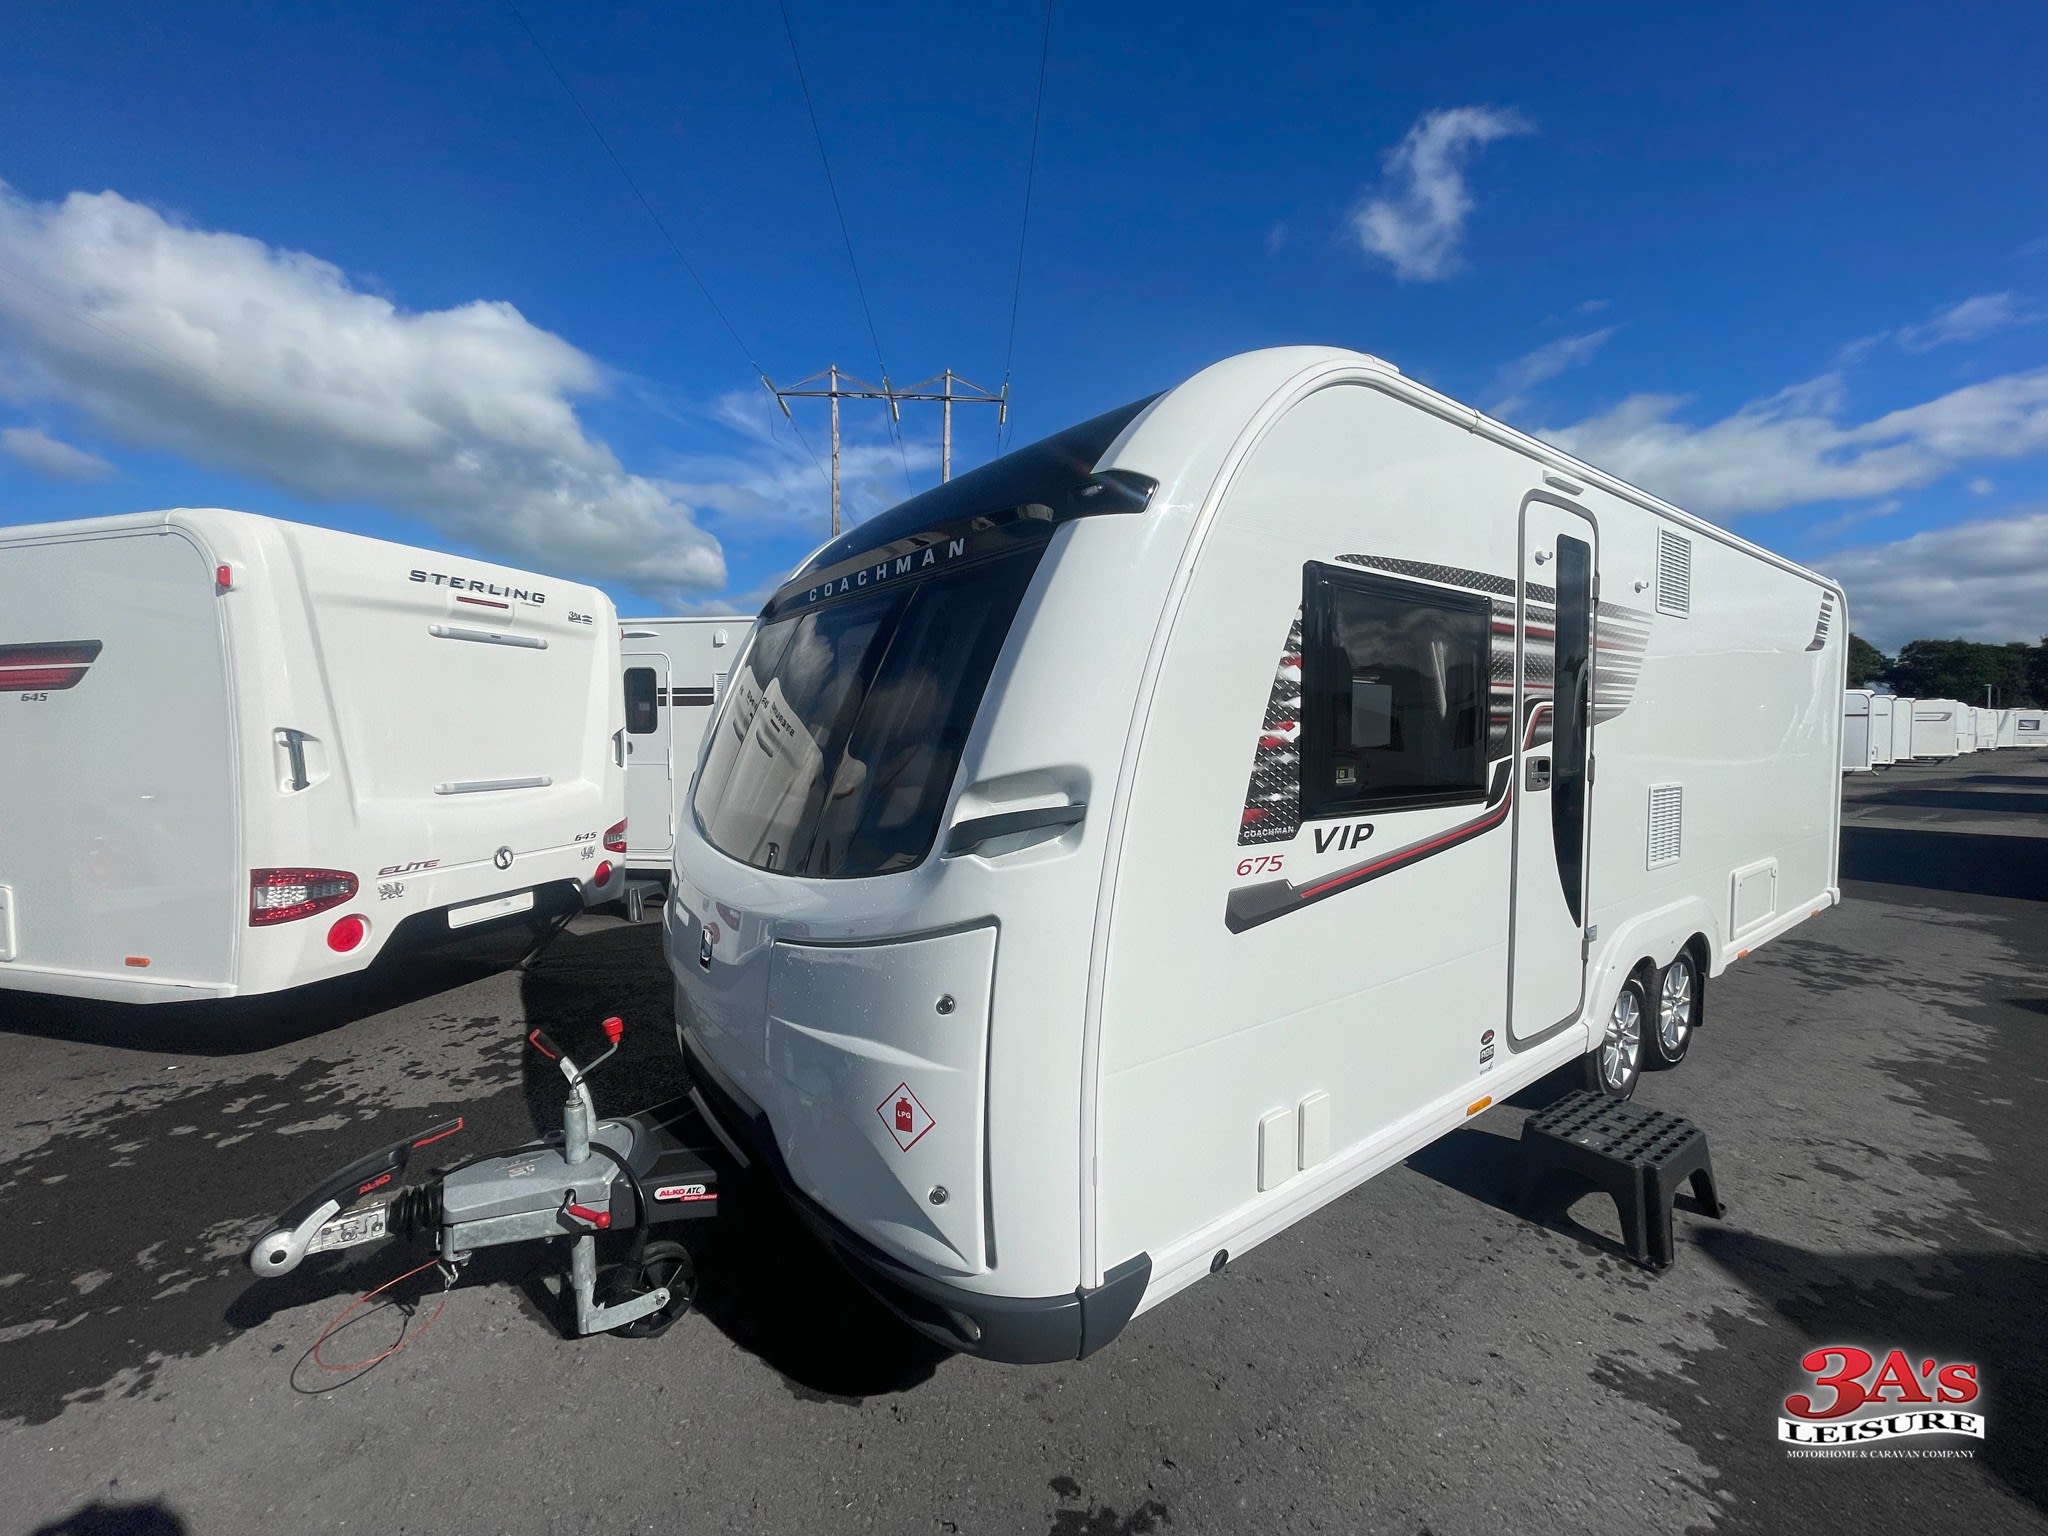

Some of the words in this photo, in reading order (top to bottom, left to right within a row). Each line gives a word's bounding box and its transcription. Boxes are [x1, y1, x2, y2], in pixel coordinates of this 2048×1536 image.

[809, 537, 965, 602] COACHMAN
[408, 569, 546, 604] STERLING
[21, 692, 48, 702] 645
[574, 831, 598, 842] 645
[1243, 826, 1295, 839] COACHMAN
[1313, 823, 1375, 854] VIP
[378, 858, 441, 876] ELITE
[1236, 854, 1284, 876] 675
[897, 1110, 911, 1119] LPG
[686, 1186, 702, 1195] ATC
